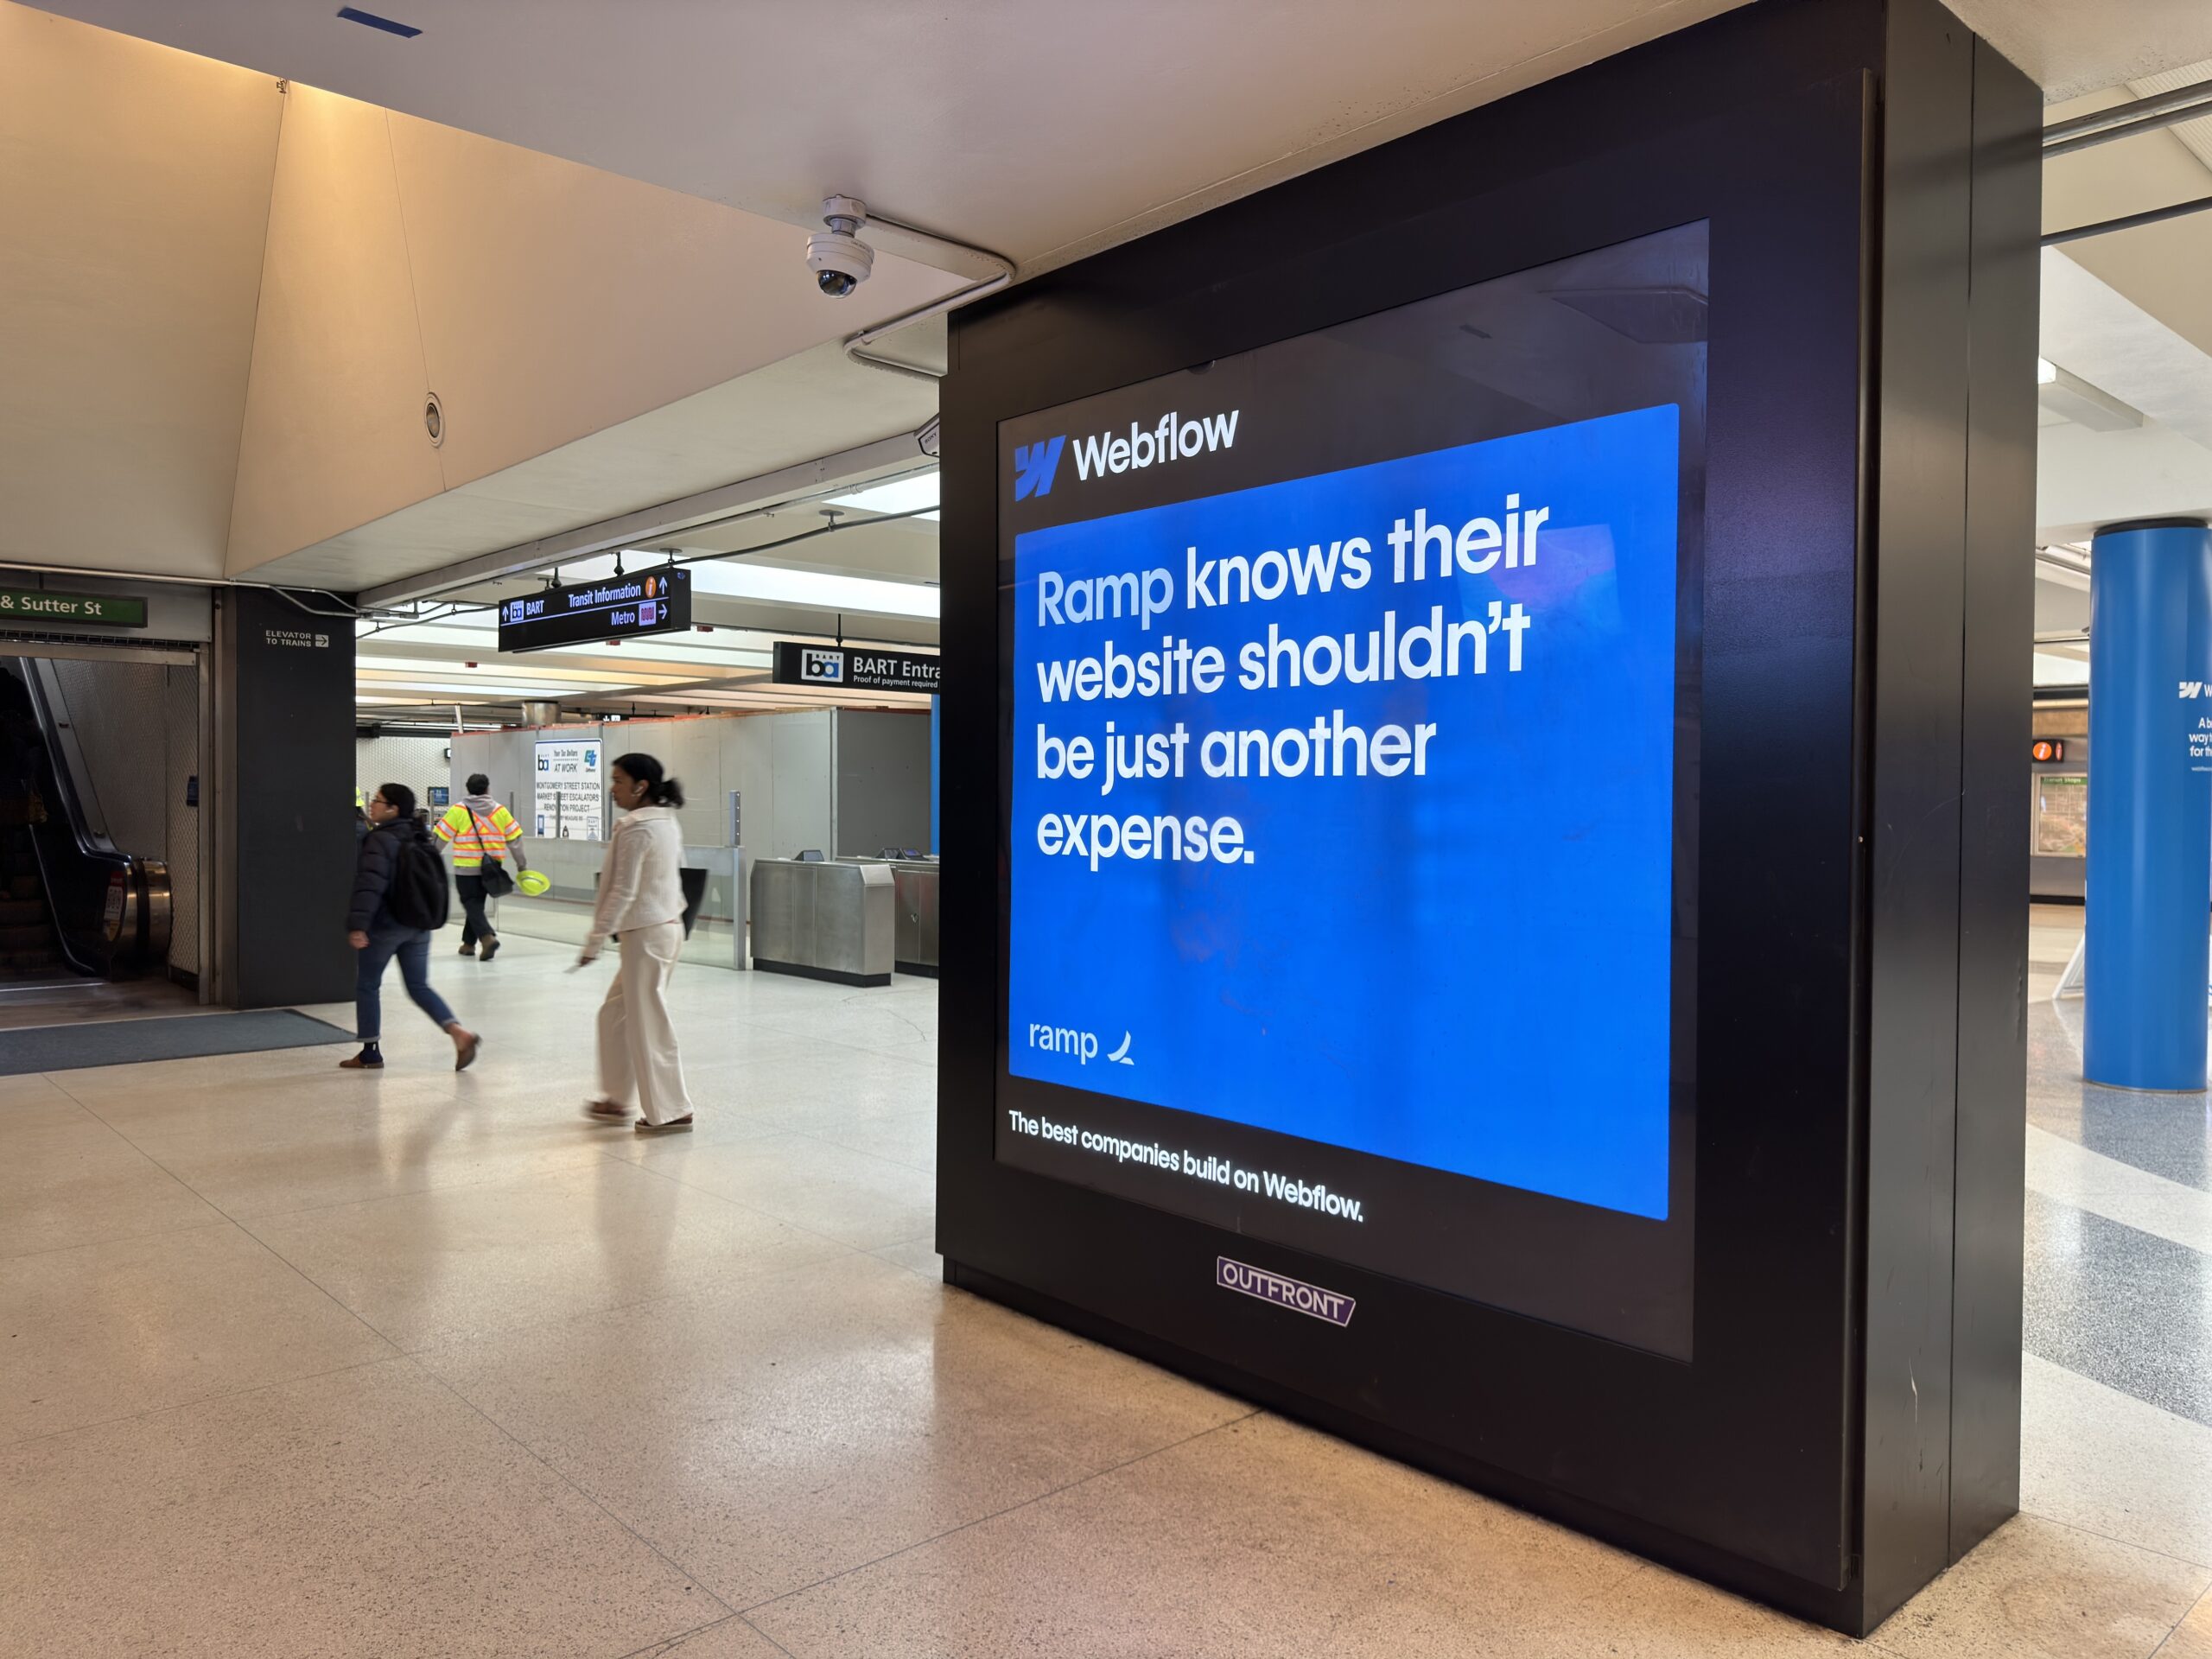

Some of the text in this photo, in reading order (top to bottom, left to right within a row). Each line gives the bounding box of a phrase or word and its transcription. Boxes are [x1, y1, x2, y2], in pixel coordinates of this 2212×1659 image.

[1073, 410, 1239, 480] Webflow
[1039, 493, 1548, 631] Ramp knows their
[568, 589, 593, 607] Transit
[594, 582, 640, 603] Information
[0, 595, 102, 615] & Sutter St
[526, 600, 544, 615] BART
[611, 611, 636, 626] Metro
[265, 630, 312, 639] ELEVATOR
[1037, 601, 1531, 702] website shouldn’t
[854, 657, 898, 676] BART
[853, 675, 871, 683] Proof
[881, 678, 910, 687] payment
[912, 680, 938, 689] required
[2198, 717, 2206, 728] A
[2189, 732, 2209, 745] way
[1037, 709, 1437, 796] be just another
[2190, 746, 2204, 757] for
[554, 764, 561, 772] AT
[562, 764, 578, 772] WORK
[569, 793, 600, 802] ESCALATORS
[1037, 813, 1255, 872] expense.
[1029, 1023, 1098, 1065] ramp
[1008, 1109, 1363, 1223] The best companies build on Webflow.
[1223, 1262, 1344, 1319] OUTFRONT
